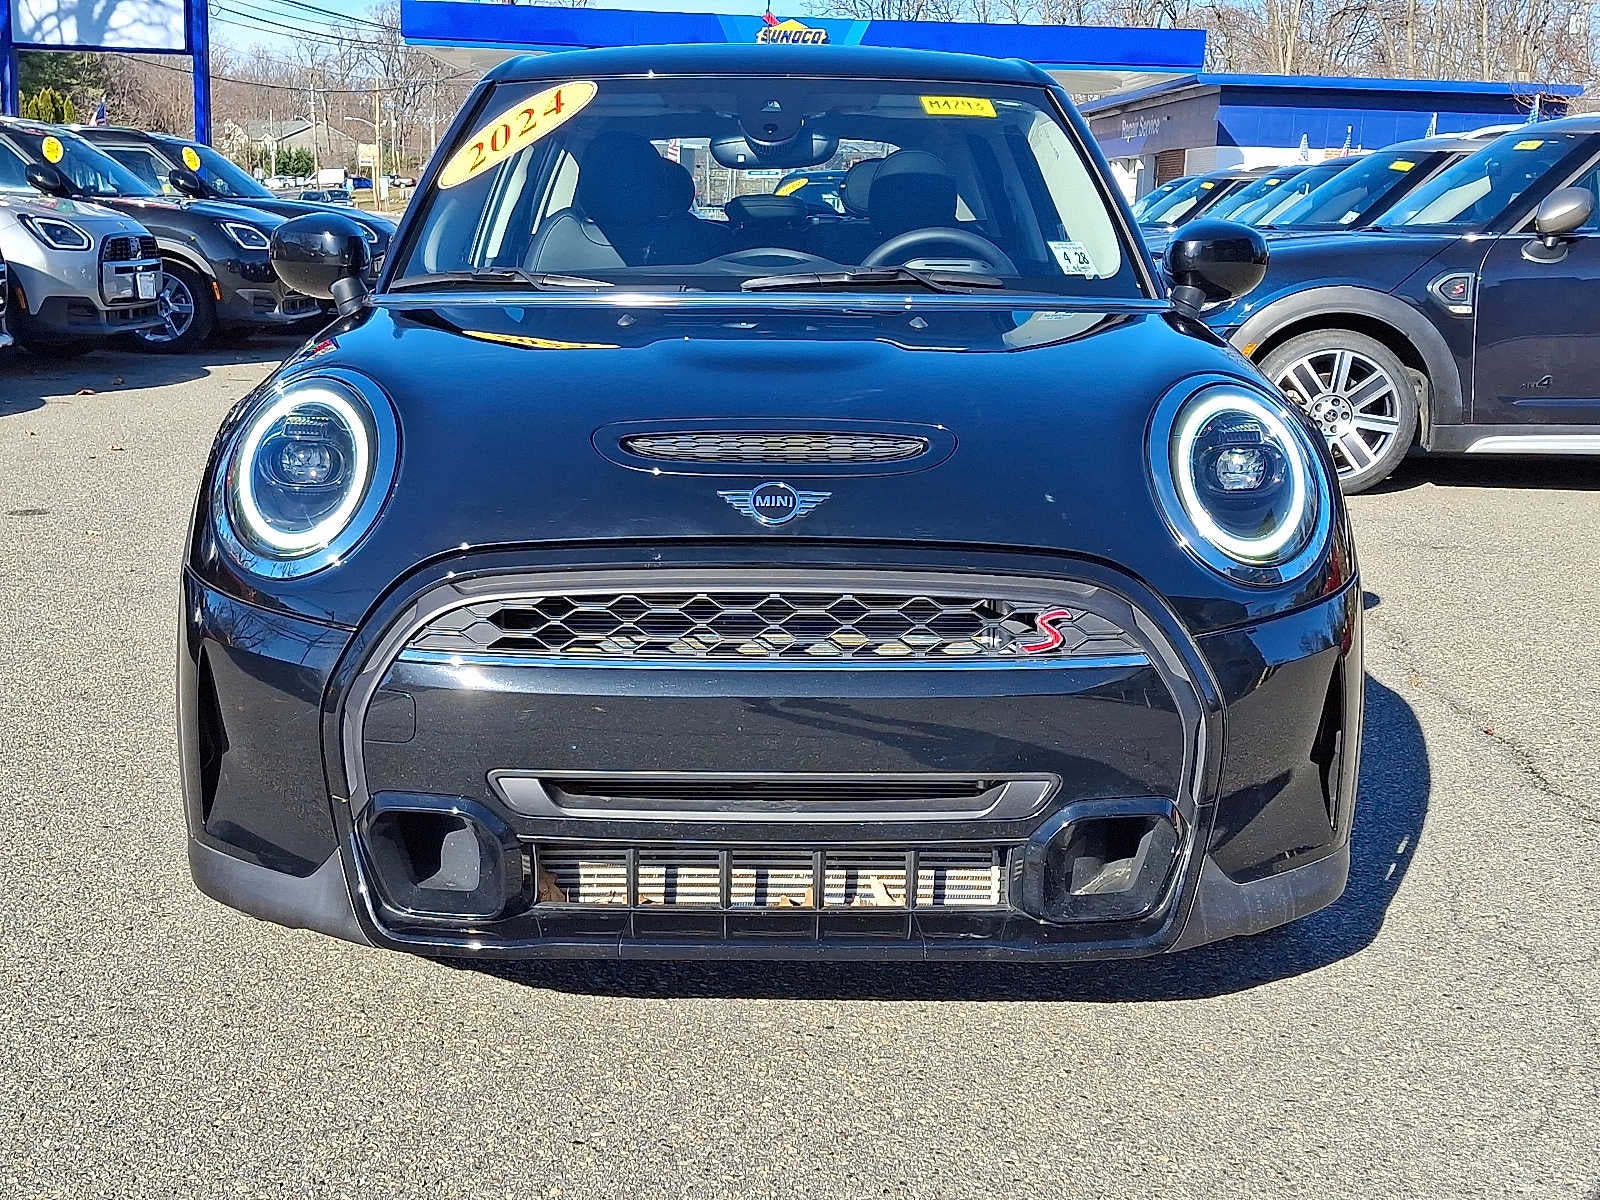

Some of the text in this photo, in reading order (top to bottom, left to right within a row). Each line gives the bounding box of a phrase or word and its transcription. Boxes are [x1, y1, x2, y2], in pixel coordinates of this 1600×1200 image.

[760, 29, 824, 44] SUNOCO
[469, 89, 565, 173] 2024
[1139, 114, 1161, 137] Service
[1063, 251, 1090, 265] 4 28
[755, 495, 793, 508] MINI
[1018, 608, 1072, 654] S
